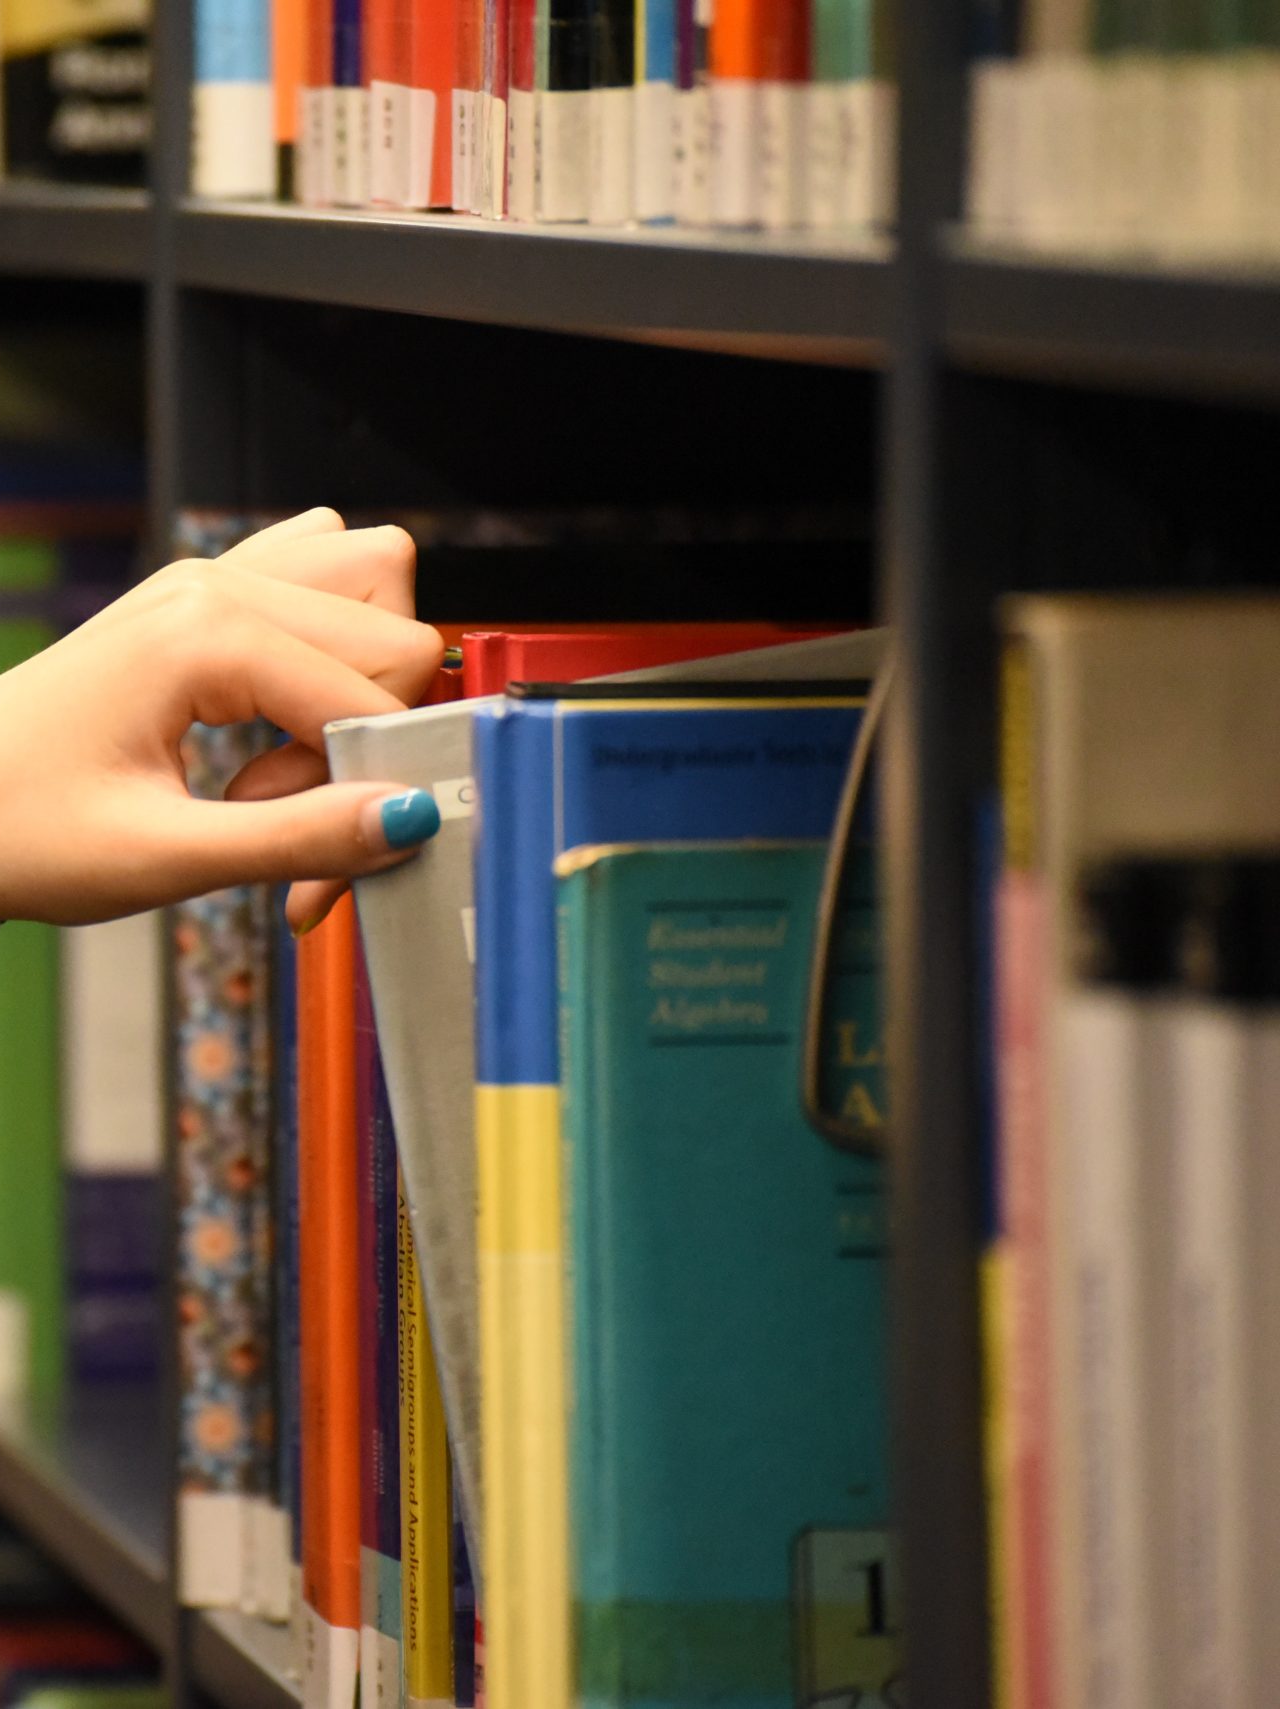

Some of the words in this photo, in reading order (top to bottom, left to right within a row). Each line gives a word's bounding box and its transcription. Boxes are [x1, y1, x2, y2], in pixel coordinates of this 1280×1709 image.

[406, 1216, 417, 1316] umerical
[406, 1322, 418, 1456] Semigroups
[408, 1462, 419, 1506] and
[407, 1511, 420, 1652] Applications
